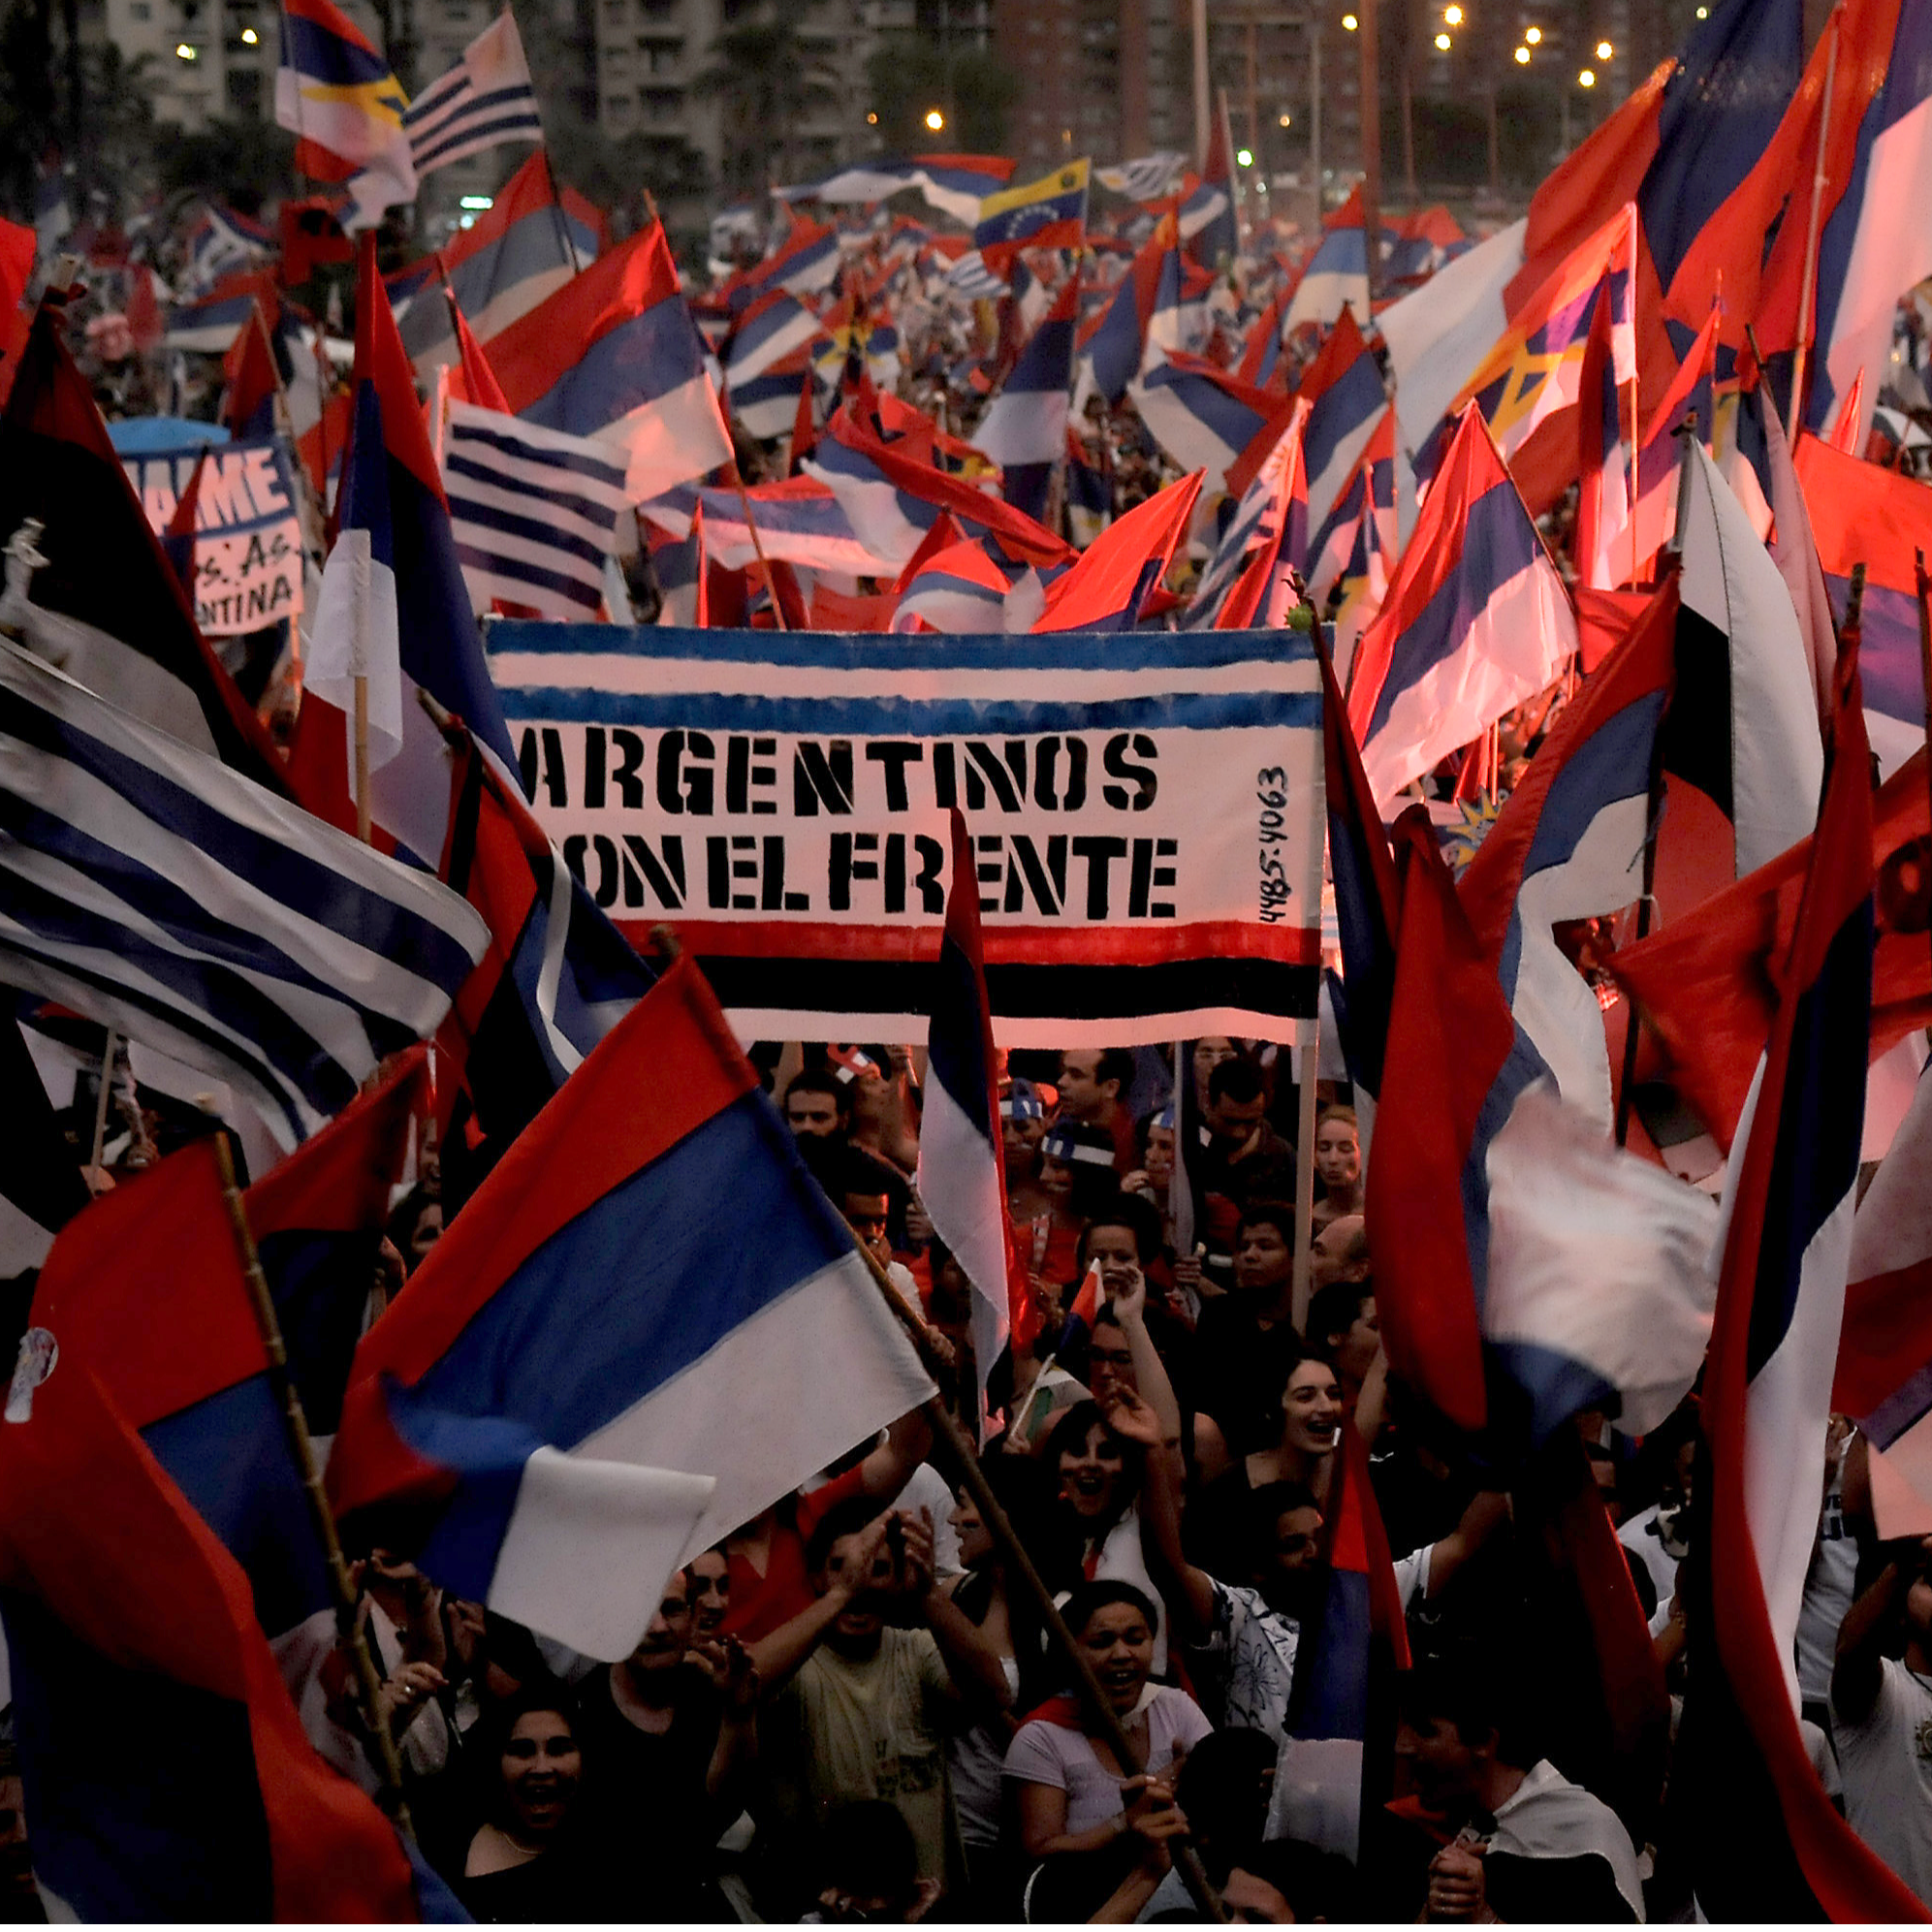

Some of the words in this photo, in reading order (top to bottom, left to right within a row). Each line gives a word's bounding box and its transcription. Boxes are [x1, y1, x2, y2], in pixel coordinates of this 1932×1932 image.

[520, 727, 1158, 816] ARGENTINOS
[551, 834, 687, 909] ON
[706, 835, 810, 912] EL
[828, 832, 1179, 921] FRENTE
